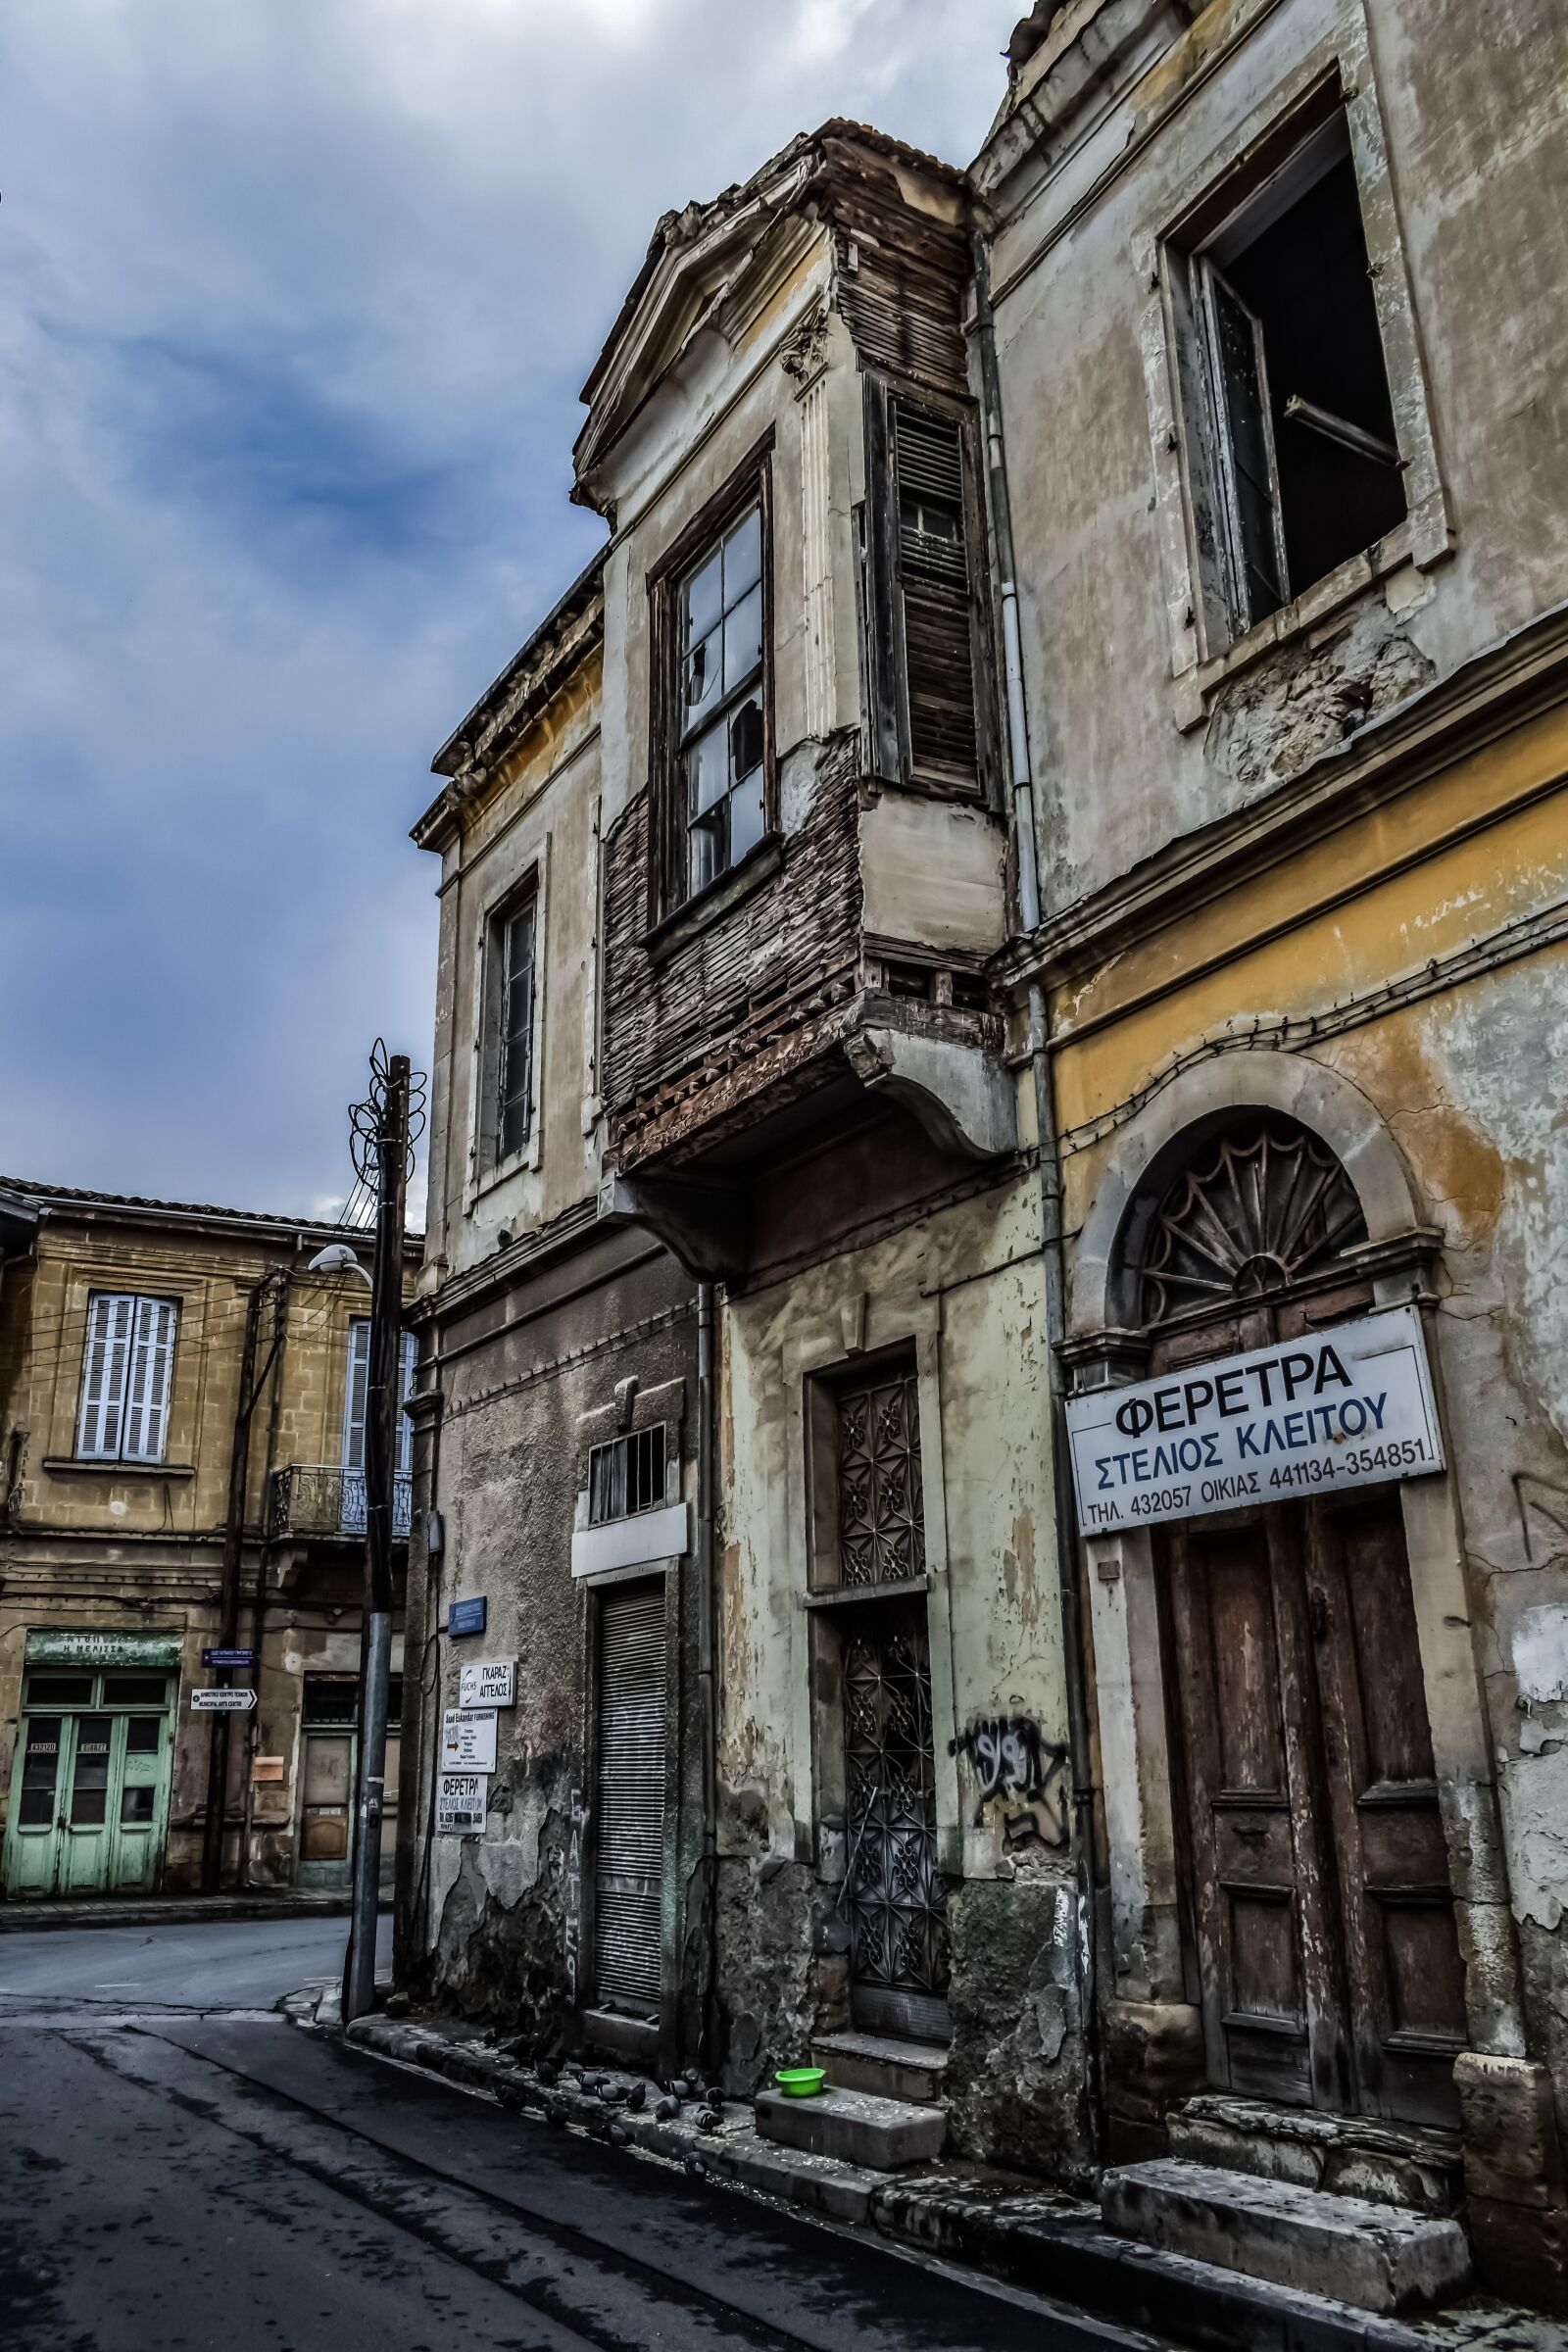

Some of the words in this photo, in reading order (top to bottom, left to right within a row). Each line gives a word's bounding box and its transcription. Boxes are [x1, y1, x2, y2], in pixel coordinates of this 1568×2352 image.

[1115, 1345, 1353, 1438] ΦΕΡΕΤΡΑ
[1088, 1499, 1124, 1525] ΤΗΛ.
[1130, 1485, 1193, 1516] 432057
[1201, 1472, 1261, 1503] ΟΙΚΙΑΣ
[1269, 1438, 1426, 1490] 441134-354851
[1095, 1432, 1223, 1490] ΣΤΕΛΙΟΣ
[1236, 1392, 1388, 1459] ΚΛΕΙΤΟΥ
[461, 1681, 477, 1691] FUCHS
[482, 1665, 508, 1681] ΓΚΑΡΑΖ
